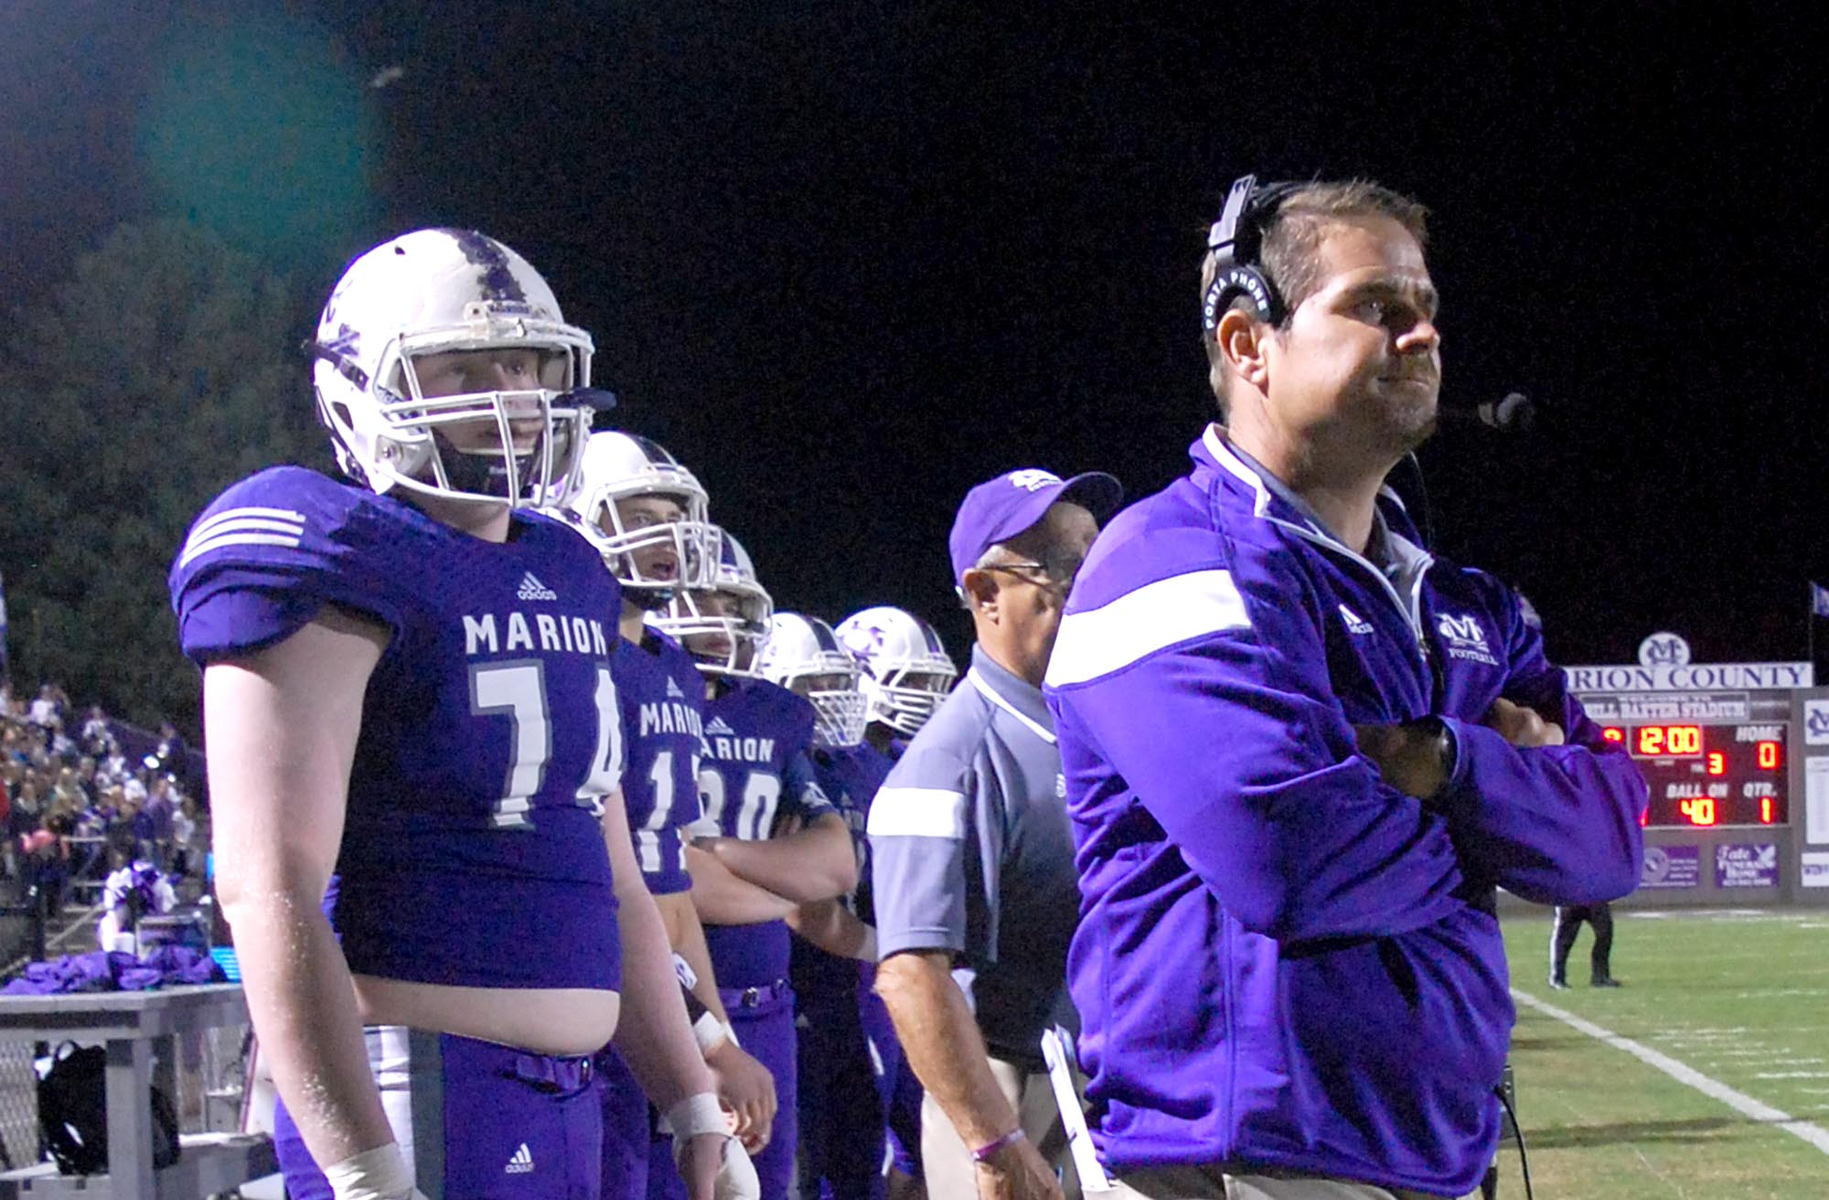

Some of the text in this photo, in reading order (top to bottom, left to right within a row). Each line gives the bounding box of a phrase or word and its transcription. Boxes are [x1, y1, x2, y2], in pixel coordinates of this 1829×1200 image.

[1204, 271, 1268, 329] PORTA PHONE
[516, 588, 557, 601] adidas
[462, 611, 608, 655] MARION
[1448, 648, 1499, 667] FOOTBALL
[1668, 664, 1806, 688] COUNTY
[1682, 701, 1745, 717] STADIUM
[468, 660, 627, 830] 74
[1639, 727, 1701, 754] 12:00
[1735, 726, 1783, 742] HOME
[1708, 752, 1724, 775] 3
[1759, 742, 1778, 768] 0
[1666, 784, 1703, 799] BALL
[1680, 798, 1716, 825] 40
[1761, 798, 1771, 823] 1
